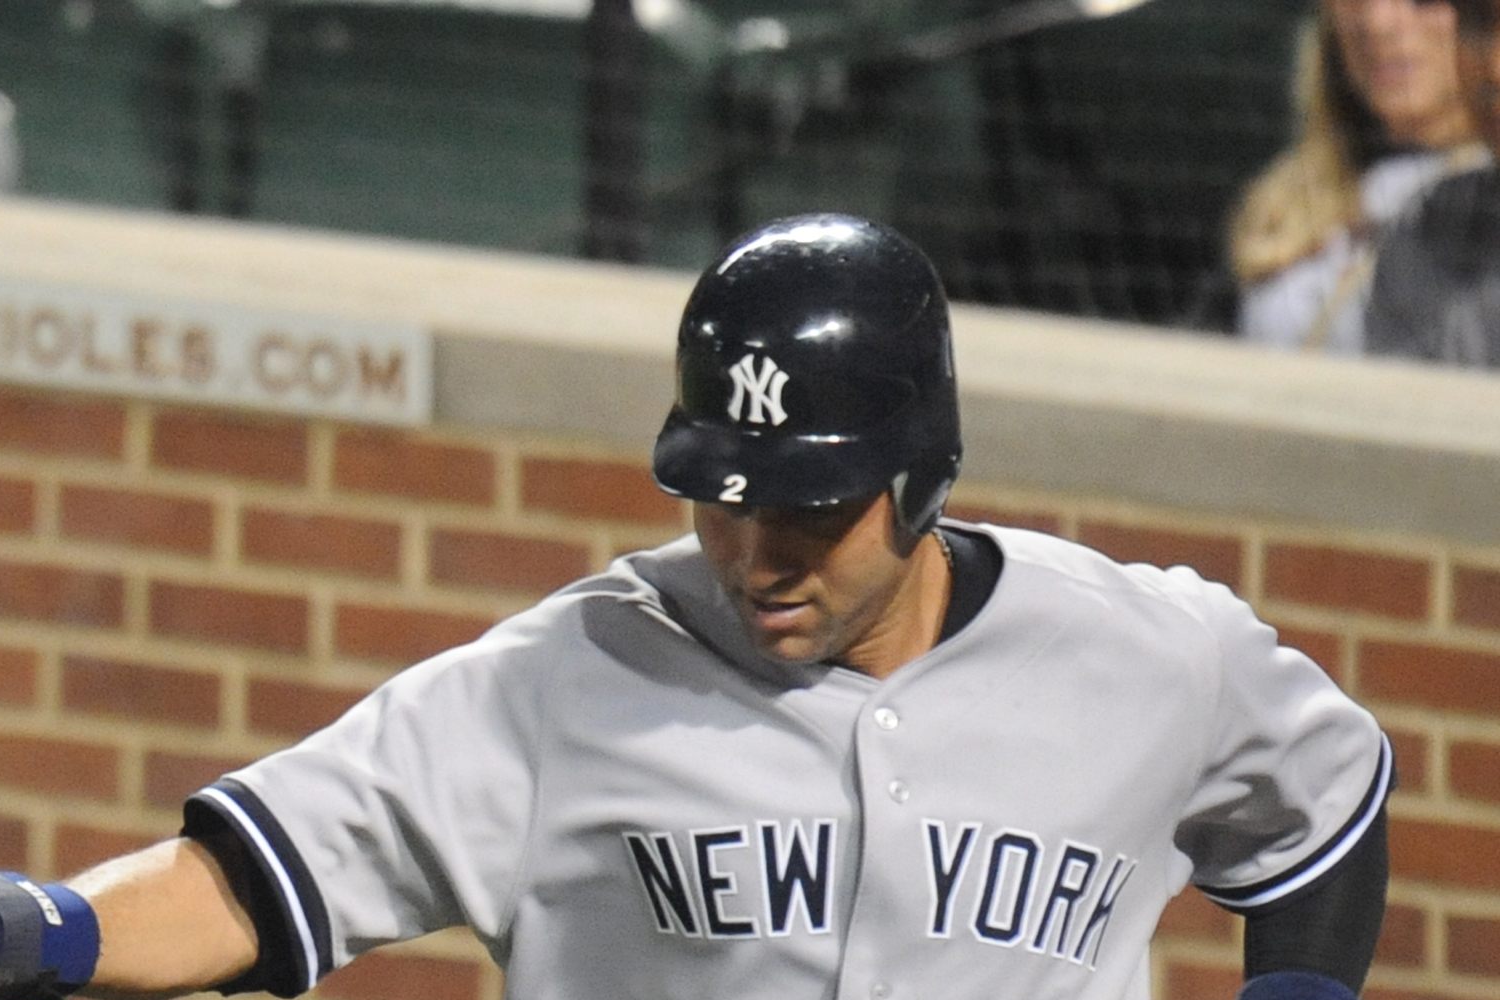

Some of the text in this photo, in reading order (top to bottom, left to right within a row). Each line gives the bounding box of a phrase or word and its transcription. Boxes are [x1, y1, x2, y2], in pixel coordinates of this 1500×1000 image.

[718, 474, 748, 503] 2
[622, 817, 1139, 973] NEW YORK
